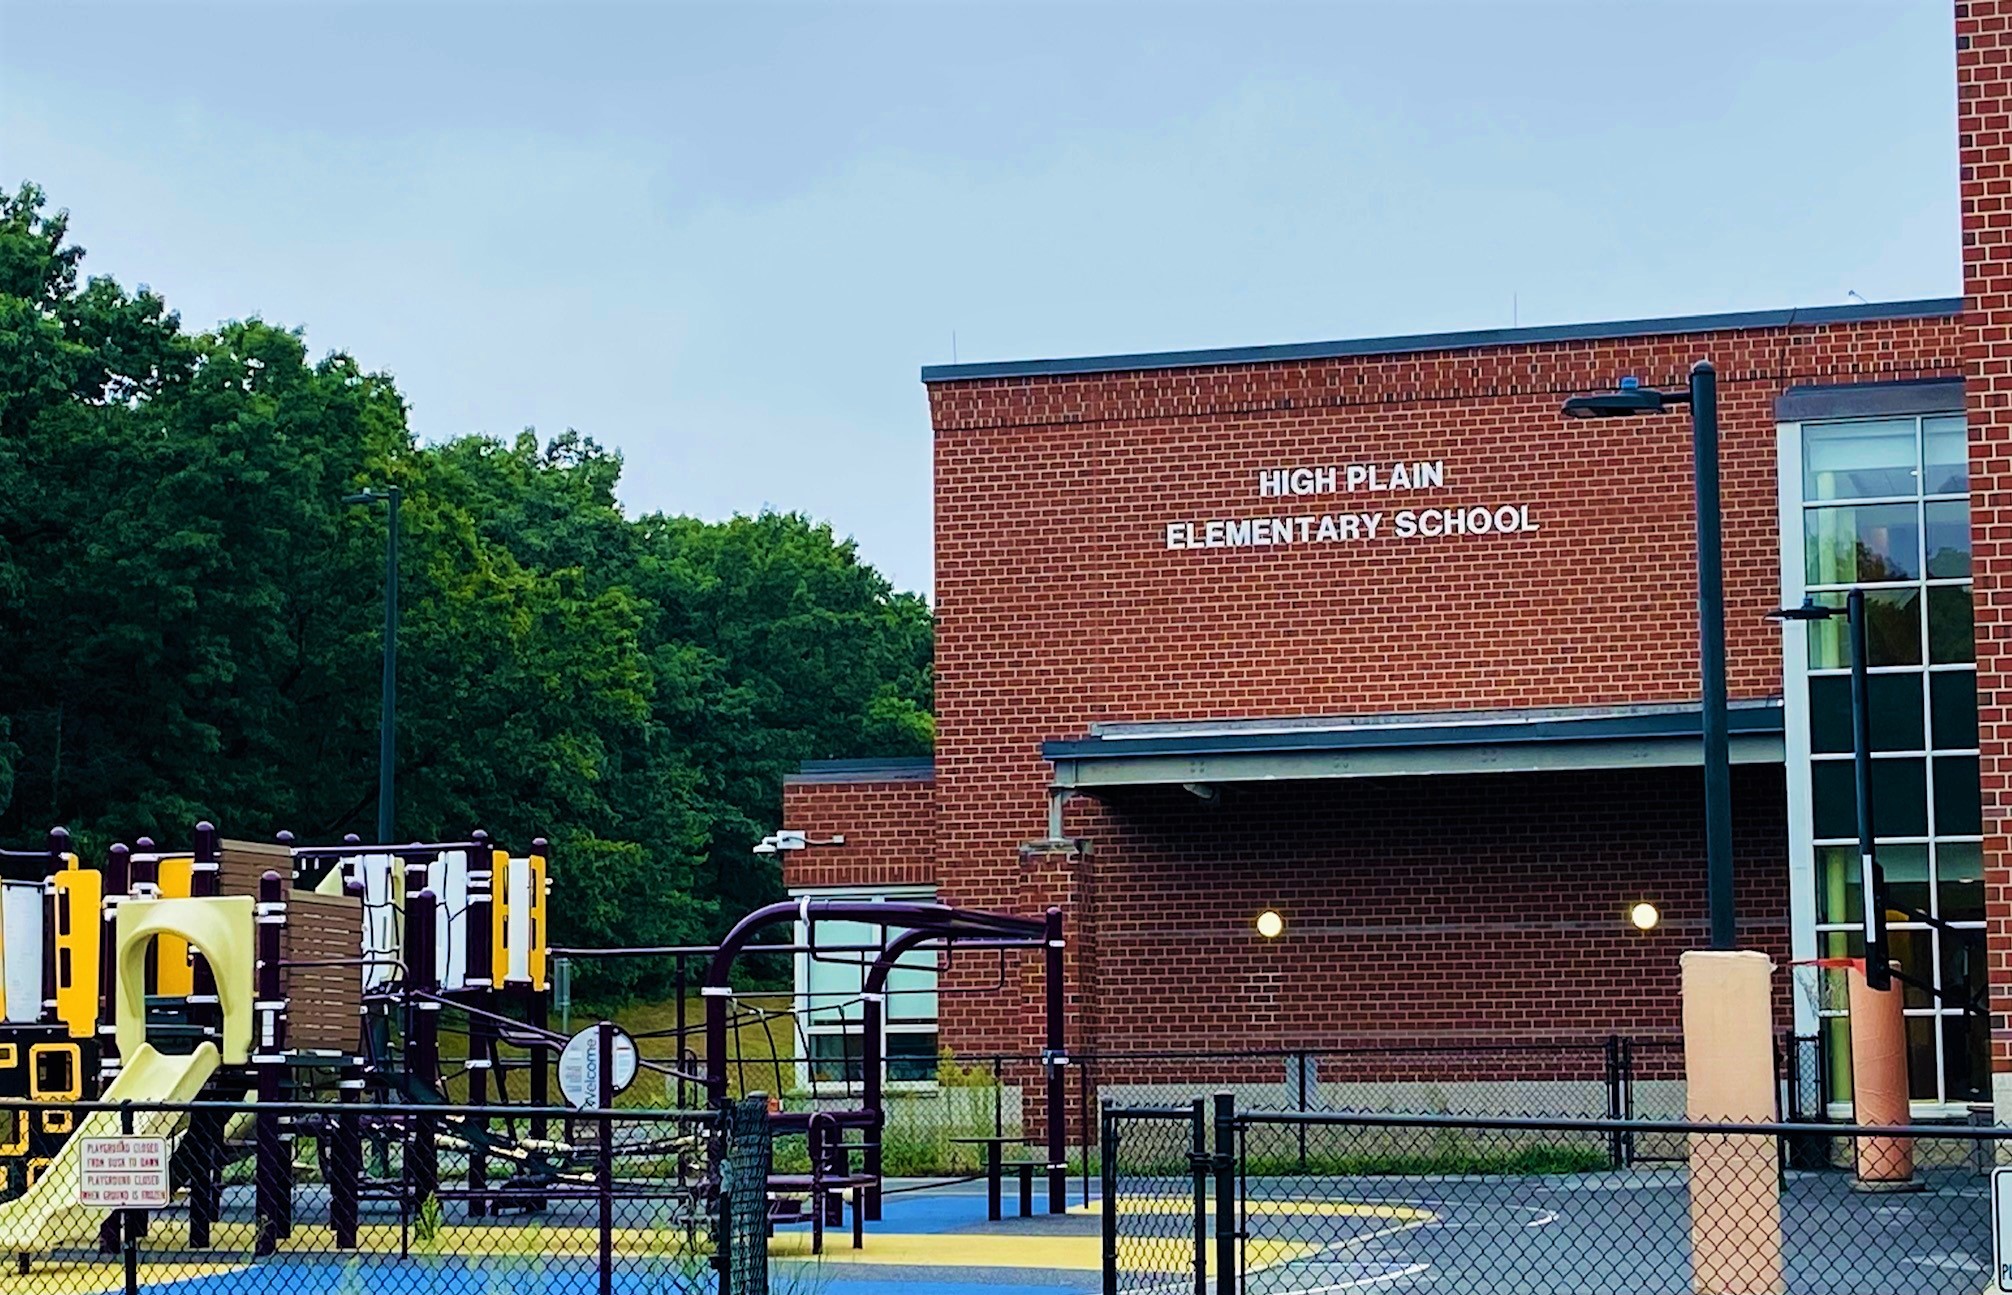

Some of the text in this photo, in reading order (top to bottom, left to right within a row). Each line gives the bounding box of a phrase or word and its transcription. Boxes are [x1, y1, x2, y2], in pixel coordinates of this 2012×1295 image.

[1259, 461, 1444, 497] HIGH PLAIN
[1166, 504, 1539, 550] ELEMENTARY SCHOOL
[584, 1038, 597, 1107] Welcome
[87, 1142, 159, 1153] PLAYGROUND CLOSED
[87, 1158, 159, 1167] FROM DUSK TO DAWN
[87, 1175, 159, 1186] PLAYGROUND CLOSED
[82, 1191, 166, 1201] WHEN GROUND IS FROZEN
